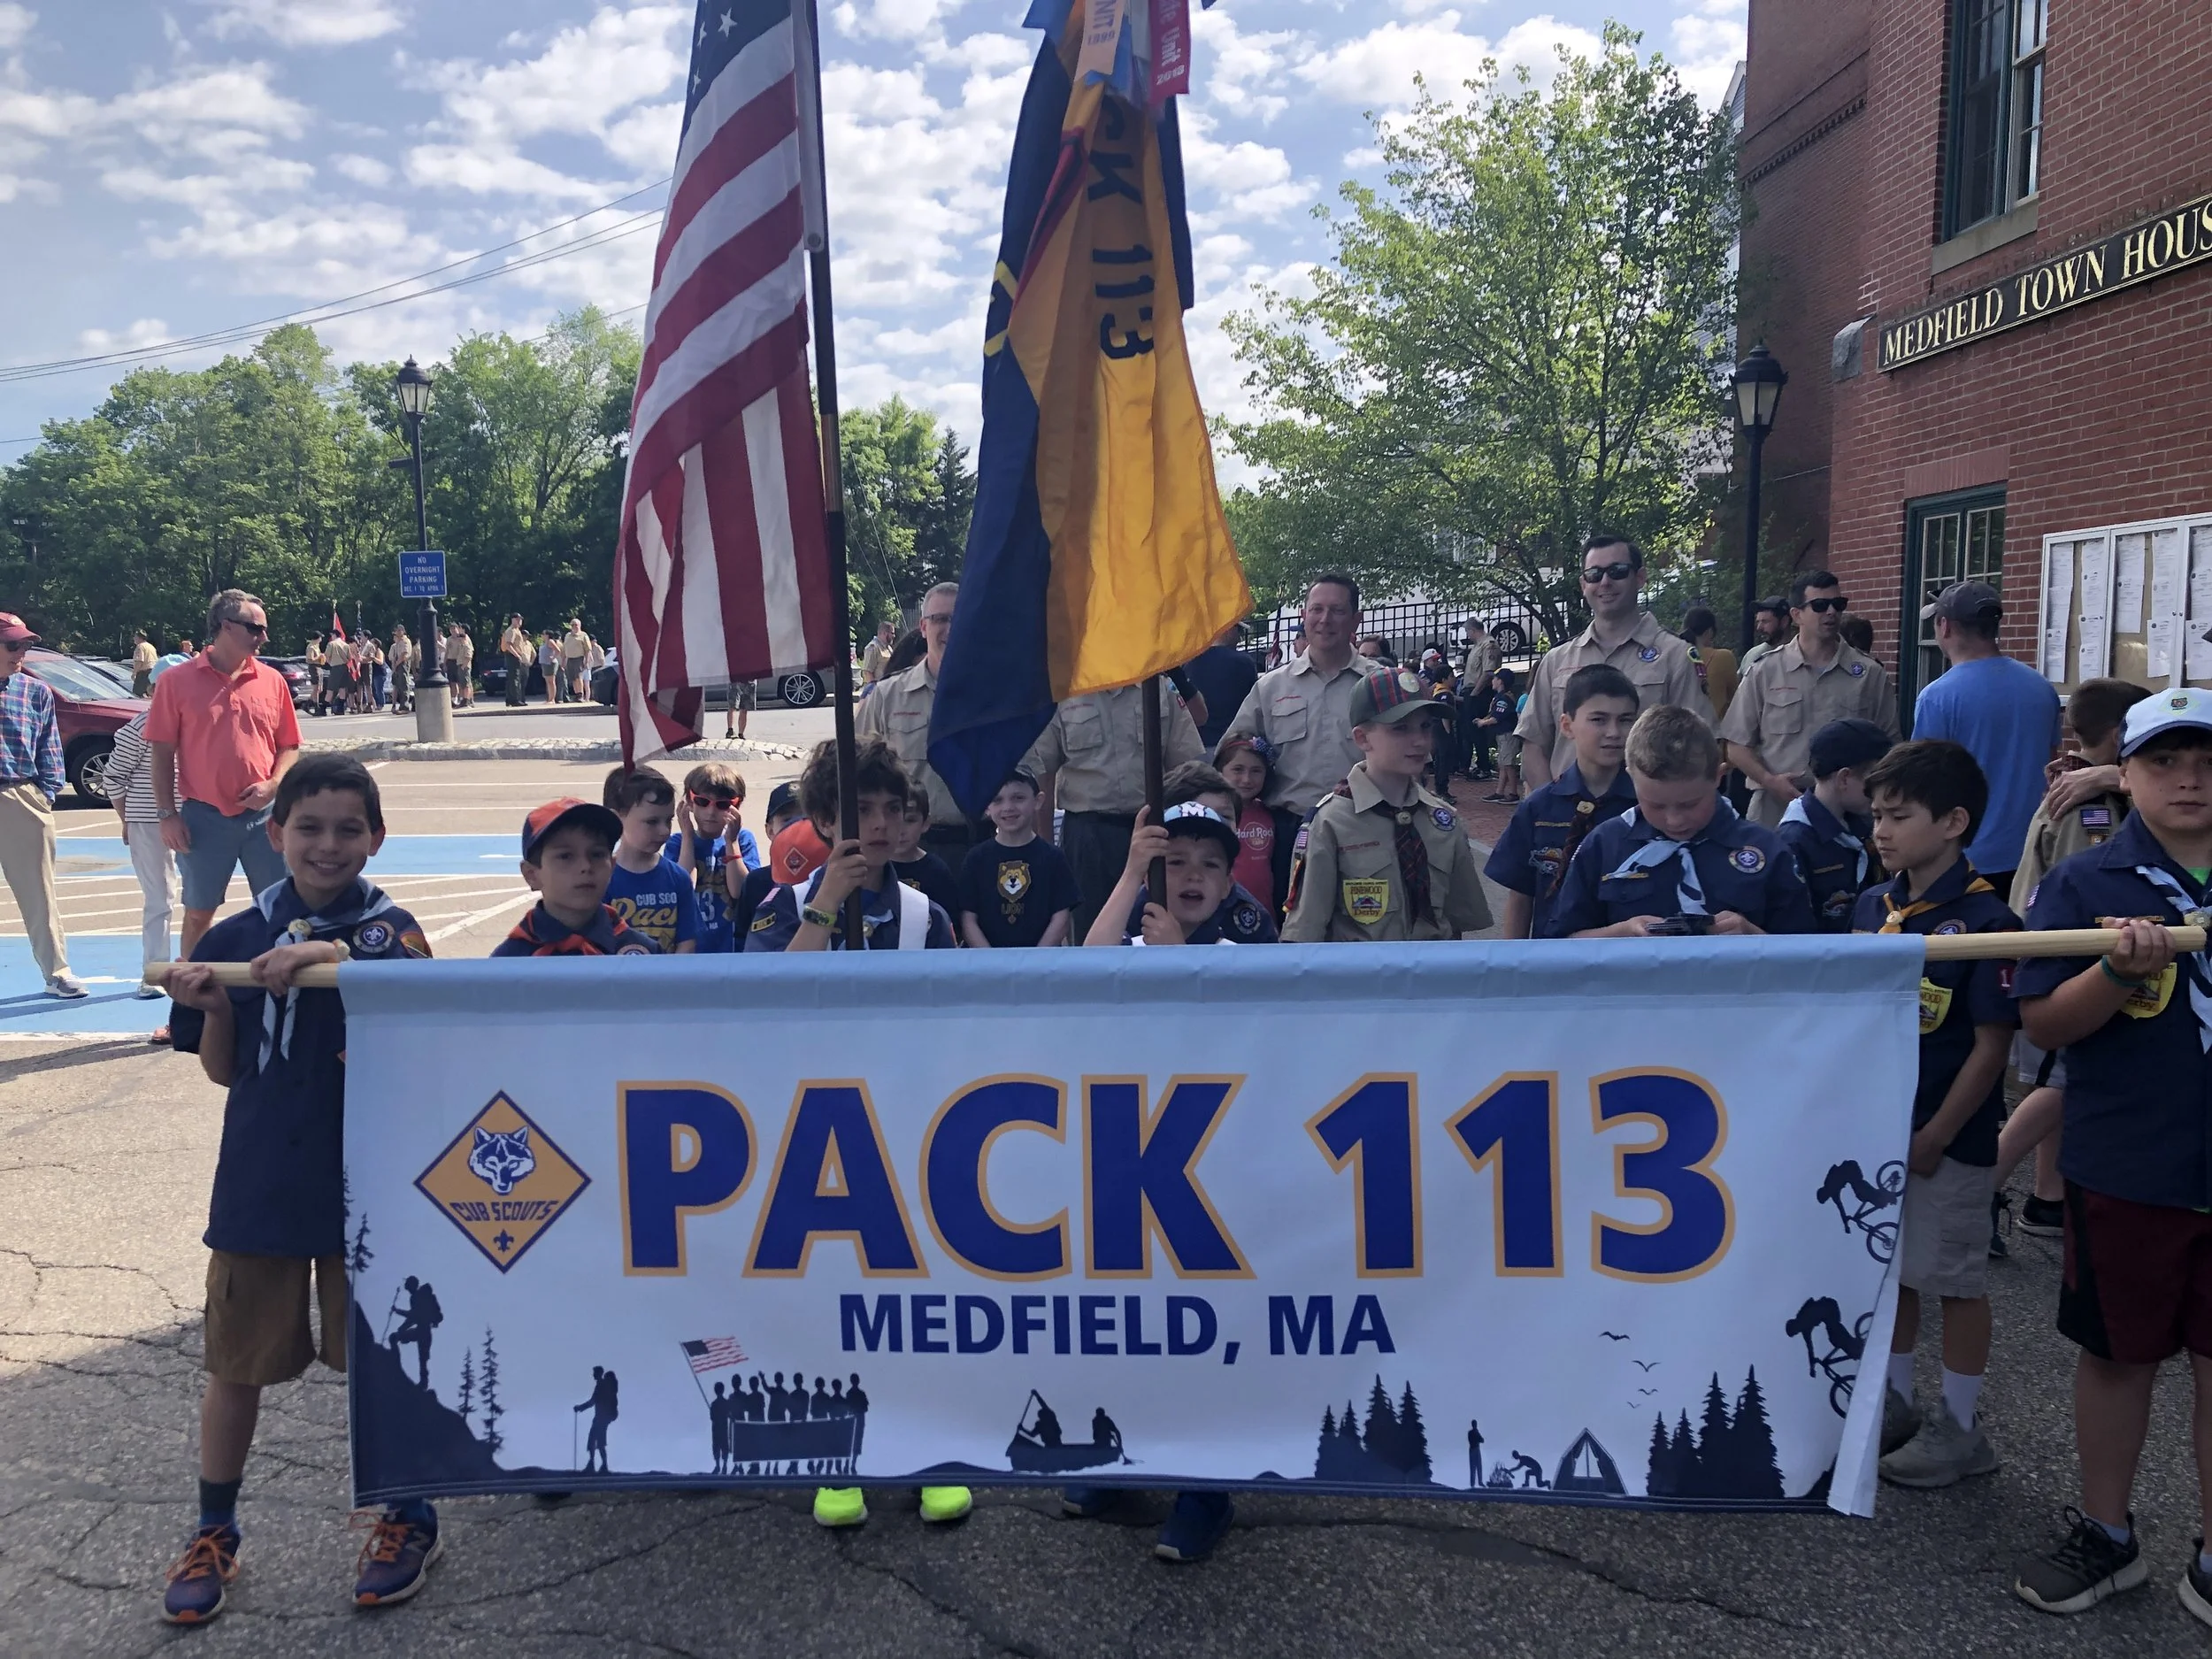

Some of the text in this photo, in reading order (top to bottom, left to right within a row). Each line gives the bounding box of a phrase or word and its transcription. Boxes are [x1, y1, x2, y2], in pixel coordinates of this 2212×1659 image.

[1092, 244, 1155, 359] 113
[1882, 288, 2004, 366] MEDFIELD
[2015, 244, 2108, 319] TOWN
[636, 894, 656, 906] CUB
[449, 1201, 559, 1221] CUB SCOUTS
[617, 1066, 1736, 1284] PACK 113
[840, 1294, 1396, 1364] MEDFIELD, MA
